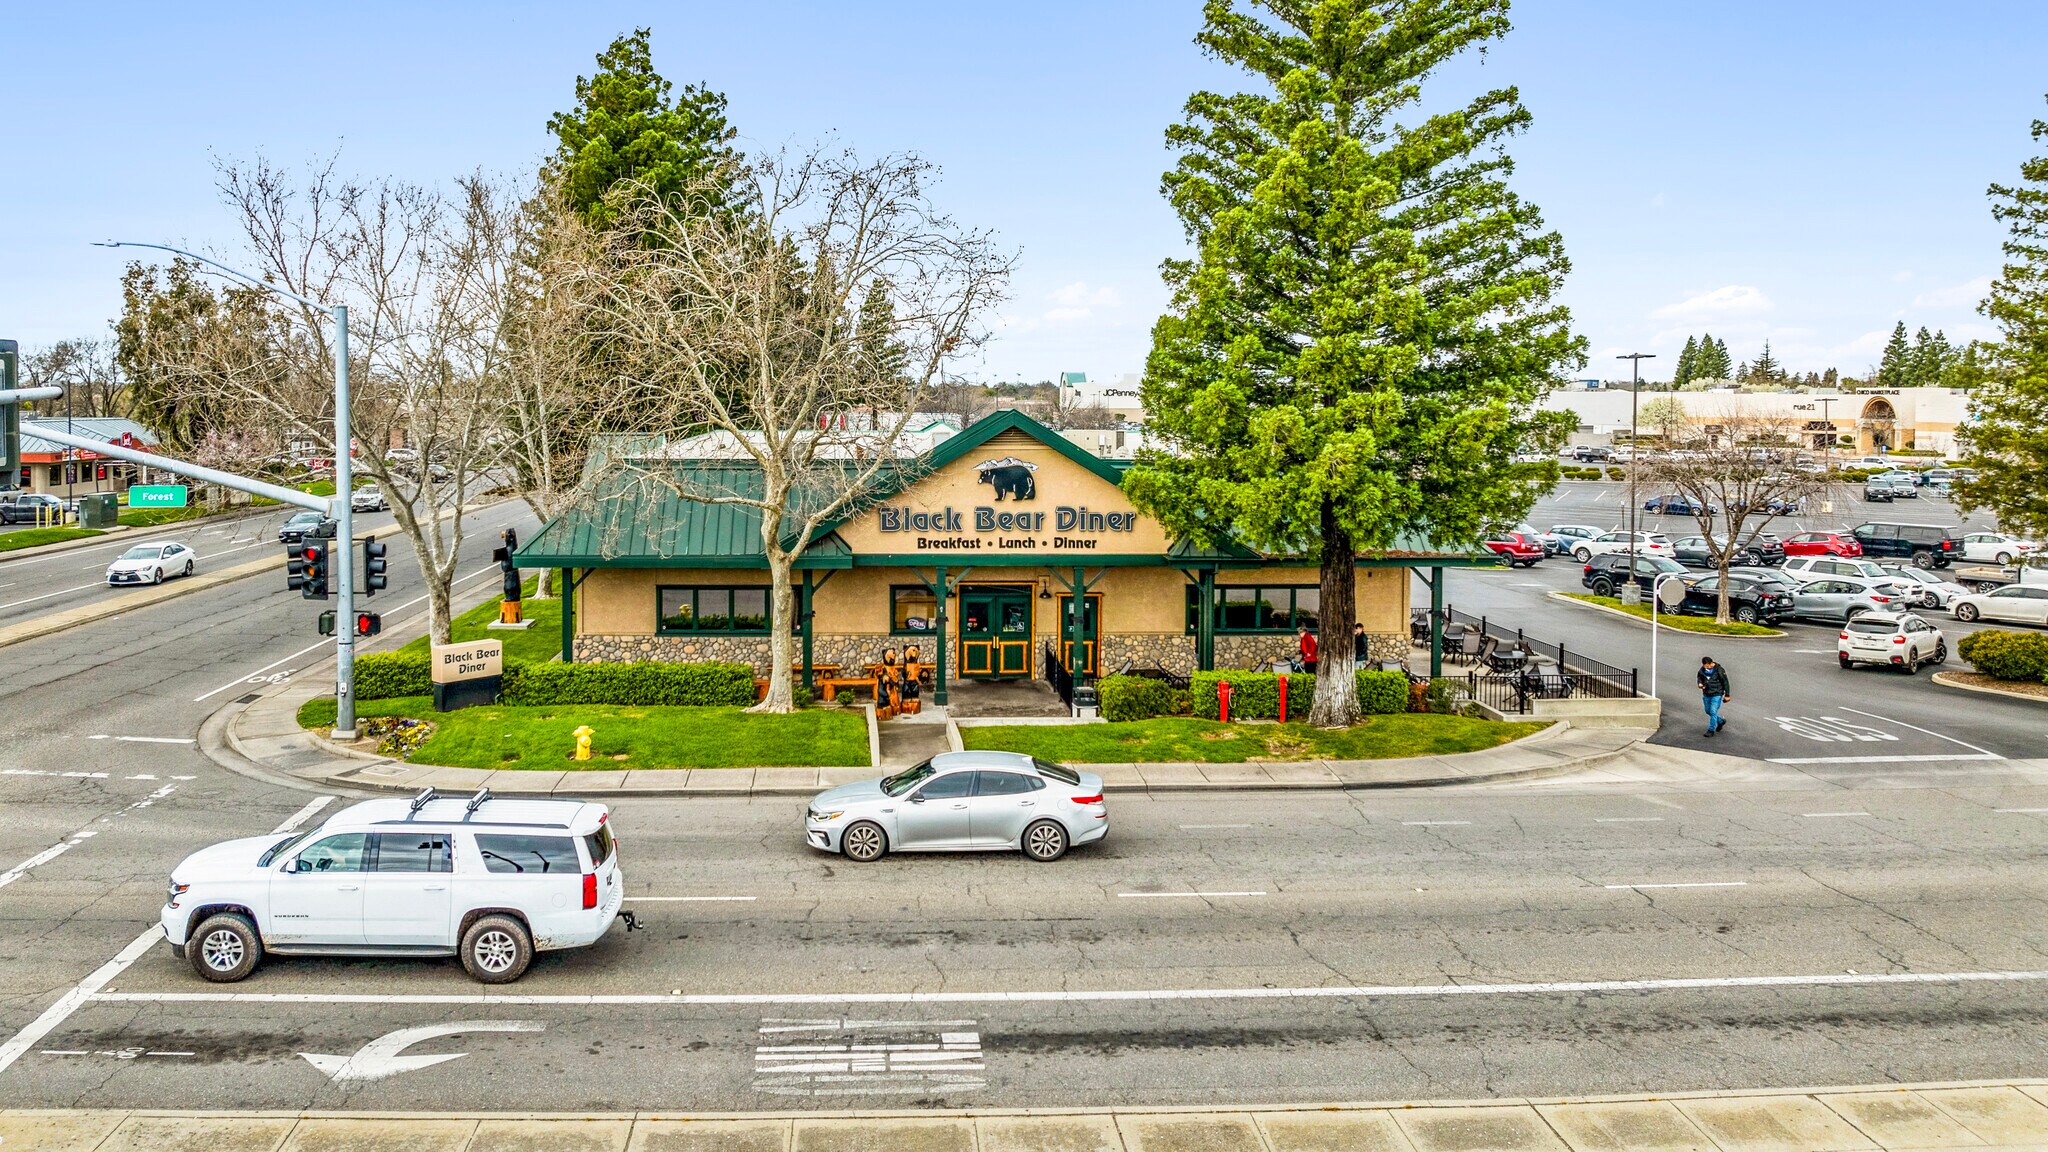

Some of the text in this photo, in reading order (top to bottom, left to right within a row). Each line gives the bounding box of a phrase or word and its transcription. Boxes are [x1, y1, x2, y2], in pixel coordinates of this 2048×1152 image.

[1103, 389, 1138, 397] JCPenney
[142, 492, 174, 501] Forest
[879, 506, 1136, 532] Black Bear Diner
[917, 537, 1097, 549] Breakfast Lunch Dinner
[444, 649, 500, 665] Black Bear
[459, 663, 487, 675] Diner
